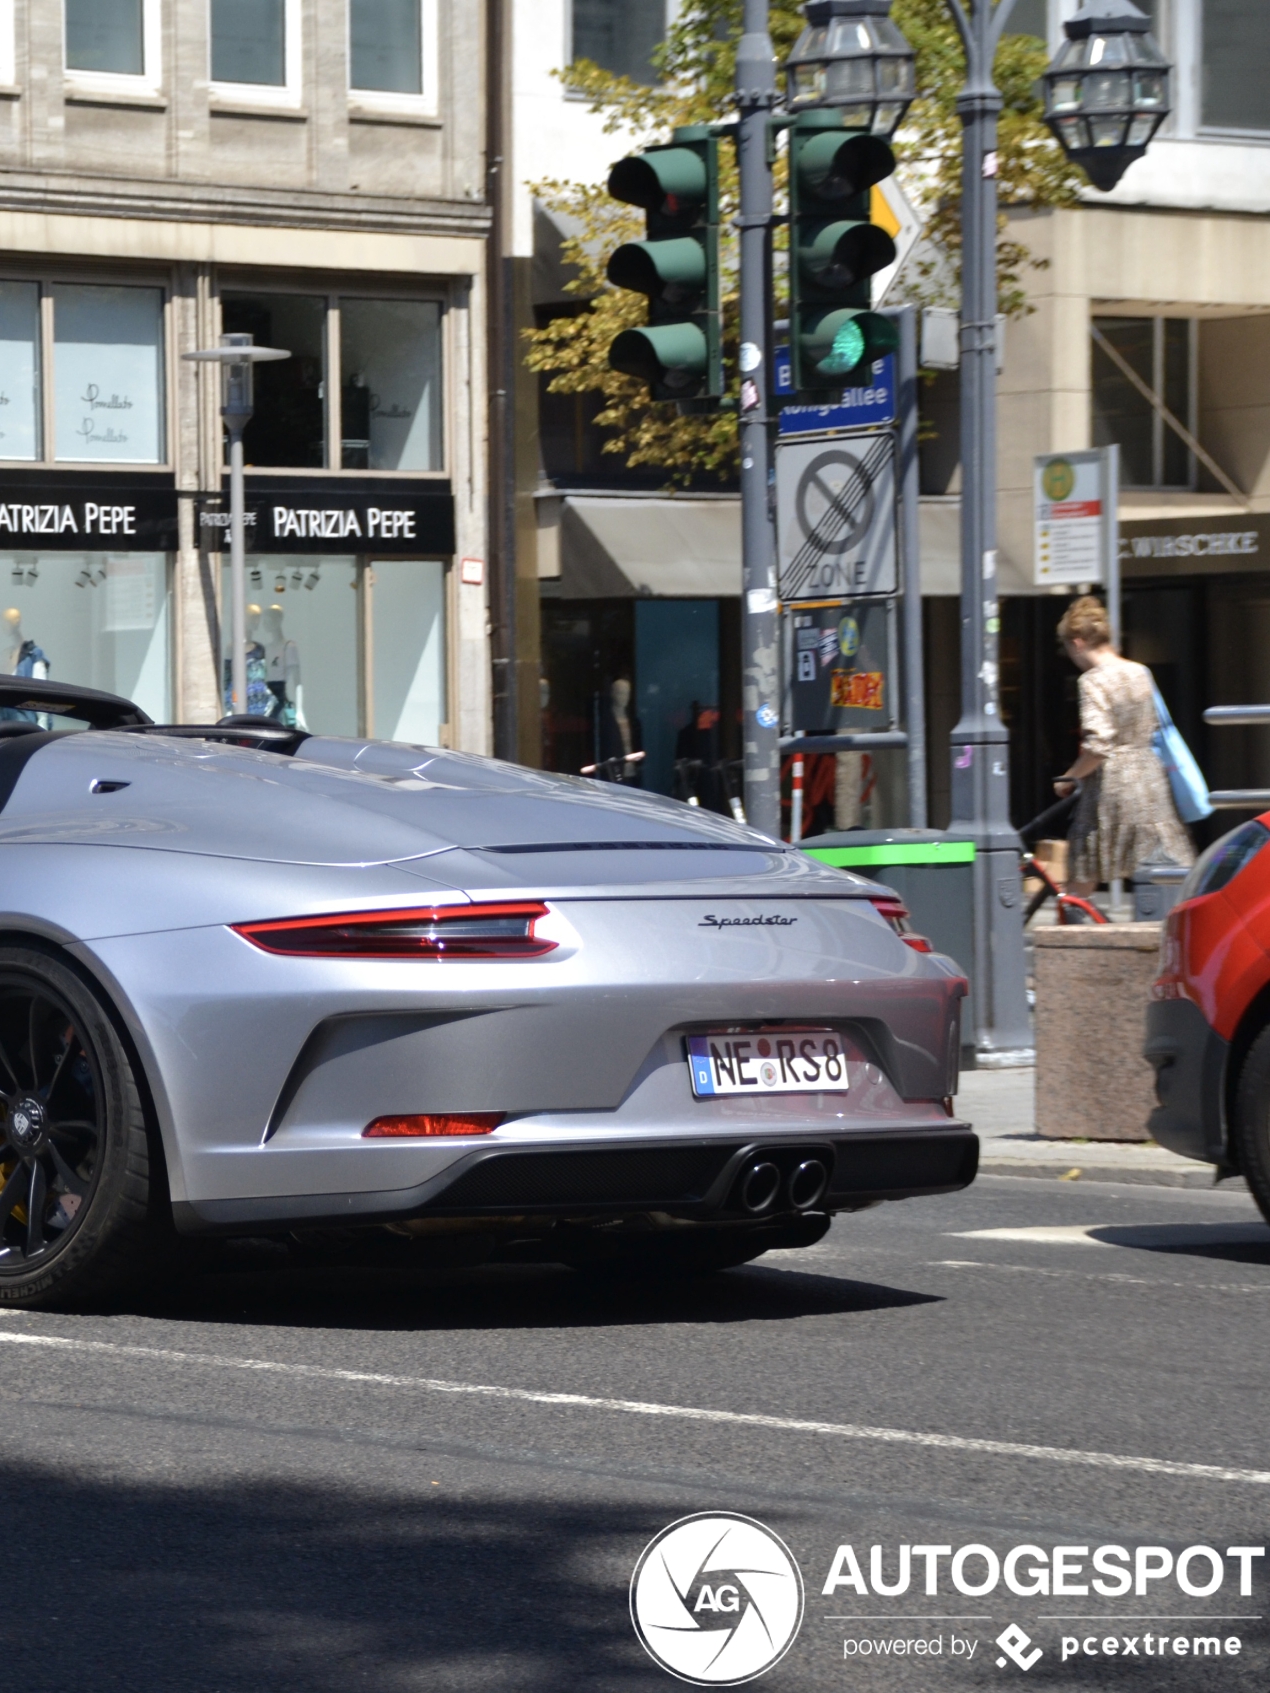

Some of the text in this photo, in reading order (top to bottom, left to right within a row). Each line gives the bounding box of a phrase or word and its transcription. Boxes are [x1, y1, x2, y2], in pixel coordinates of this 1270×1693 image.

[85, 502, 137, 535] PEPE
[273, 506, 417, 539] PATRIZIA PEPE
[806, 561, 867, 589] ZONE
[697, 914, 799, 930] Speedster
[699, 1071, 708, 1085] D
[710, 1041, 758, 1087] NE
